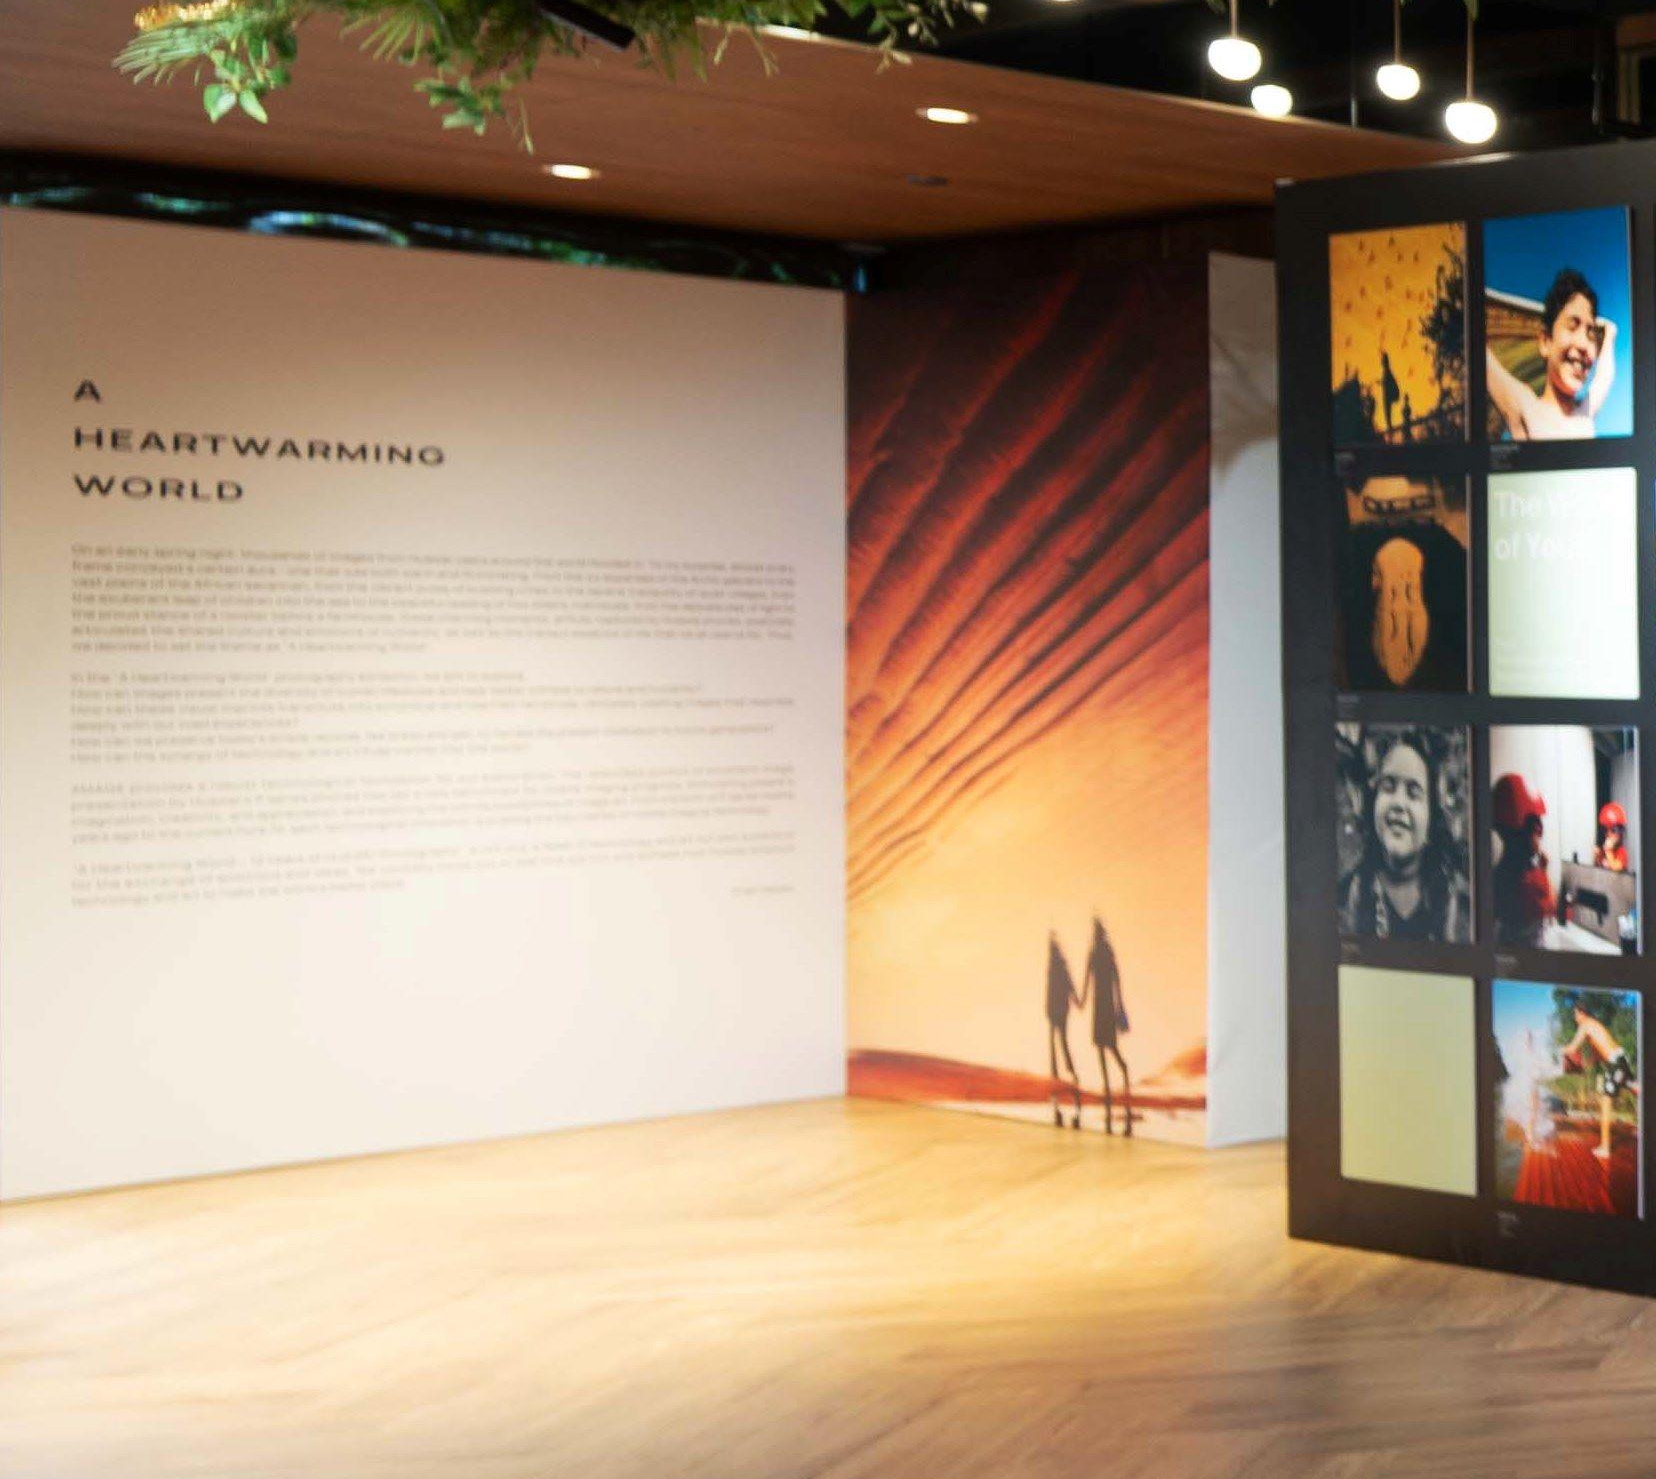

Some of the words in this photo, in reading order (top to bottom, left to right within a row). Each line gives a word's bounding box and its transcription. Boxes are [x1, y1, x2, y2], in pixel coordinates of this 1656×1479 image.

[74, 378, 102, 403] A
[74, 426, 446, 468] HEARTWARMING
[73, 473, 244, 503] WORLD
